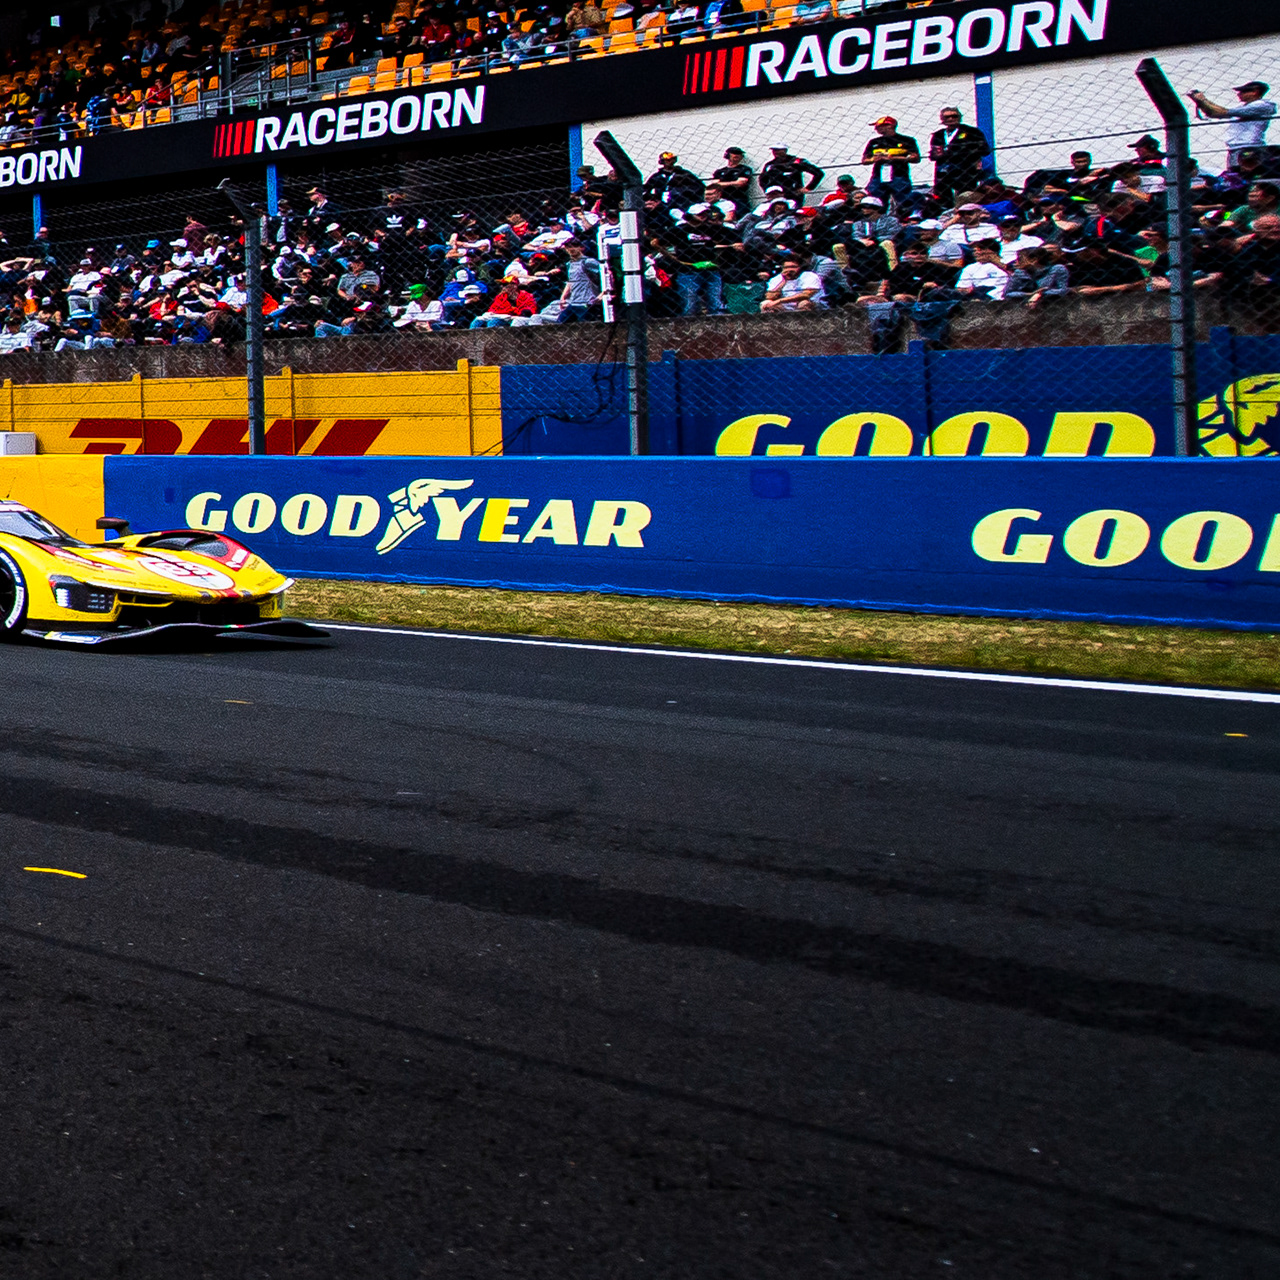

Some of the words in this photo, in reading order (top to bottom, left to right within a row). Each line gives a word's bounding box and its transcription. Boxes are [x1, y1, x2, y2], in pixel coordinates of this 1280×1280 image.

[255, 86, 484, 152] RACEBORN
[186, 492, 380, 536] GOOD
[431, 498, 652, 548] YEAR
[973, 509, 1280, 572] GOO
